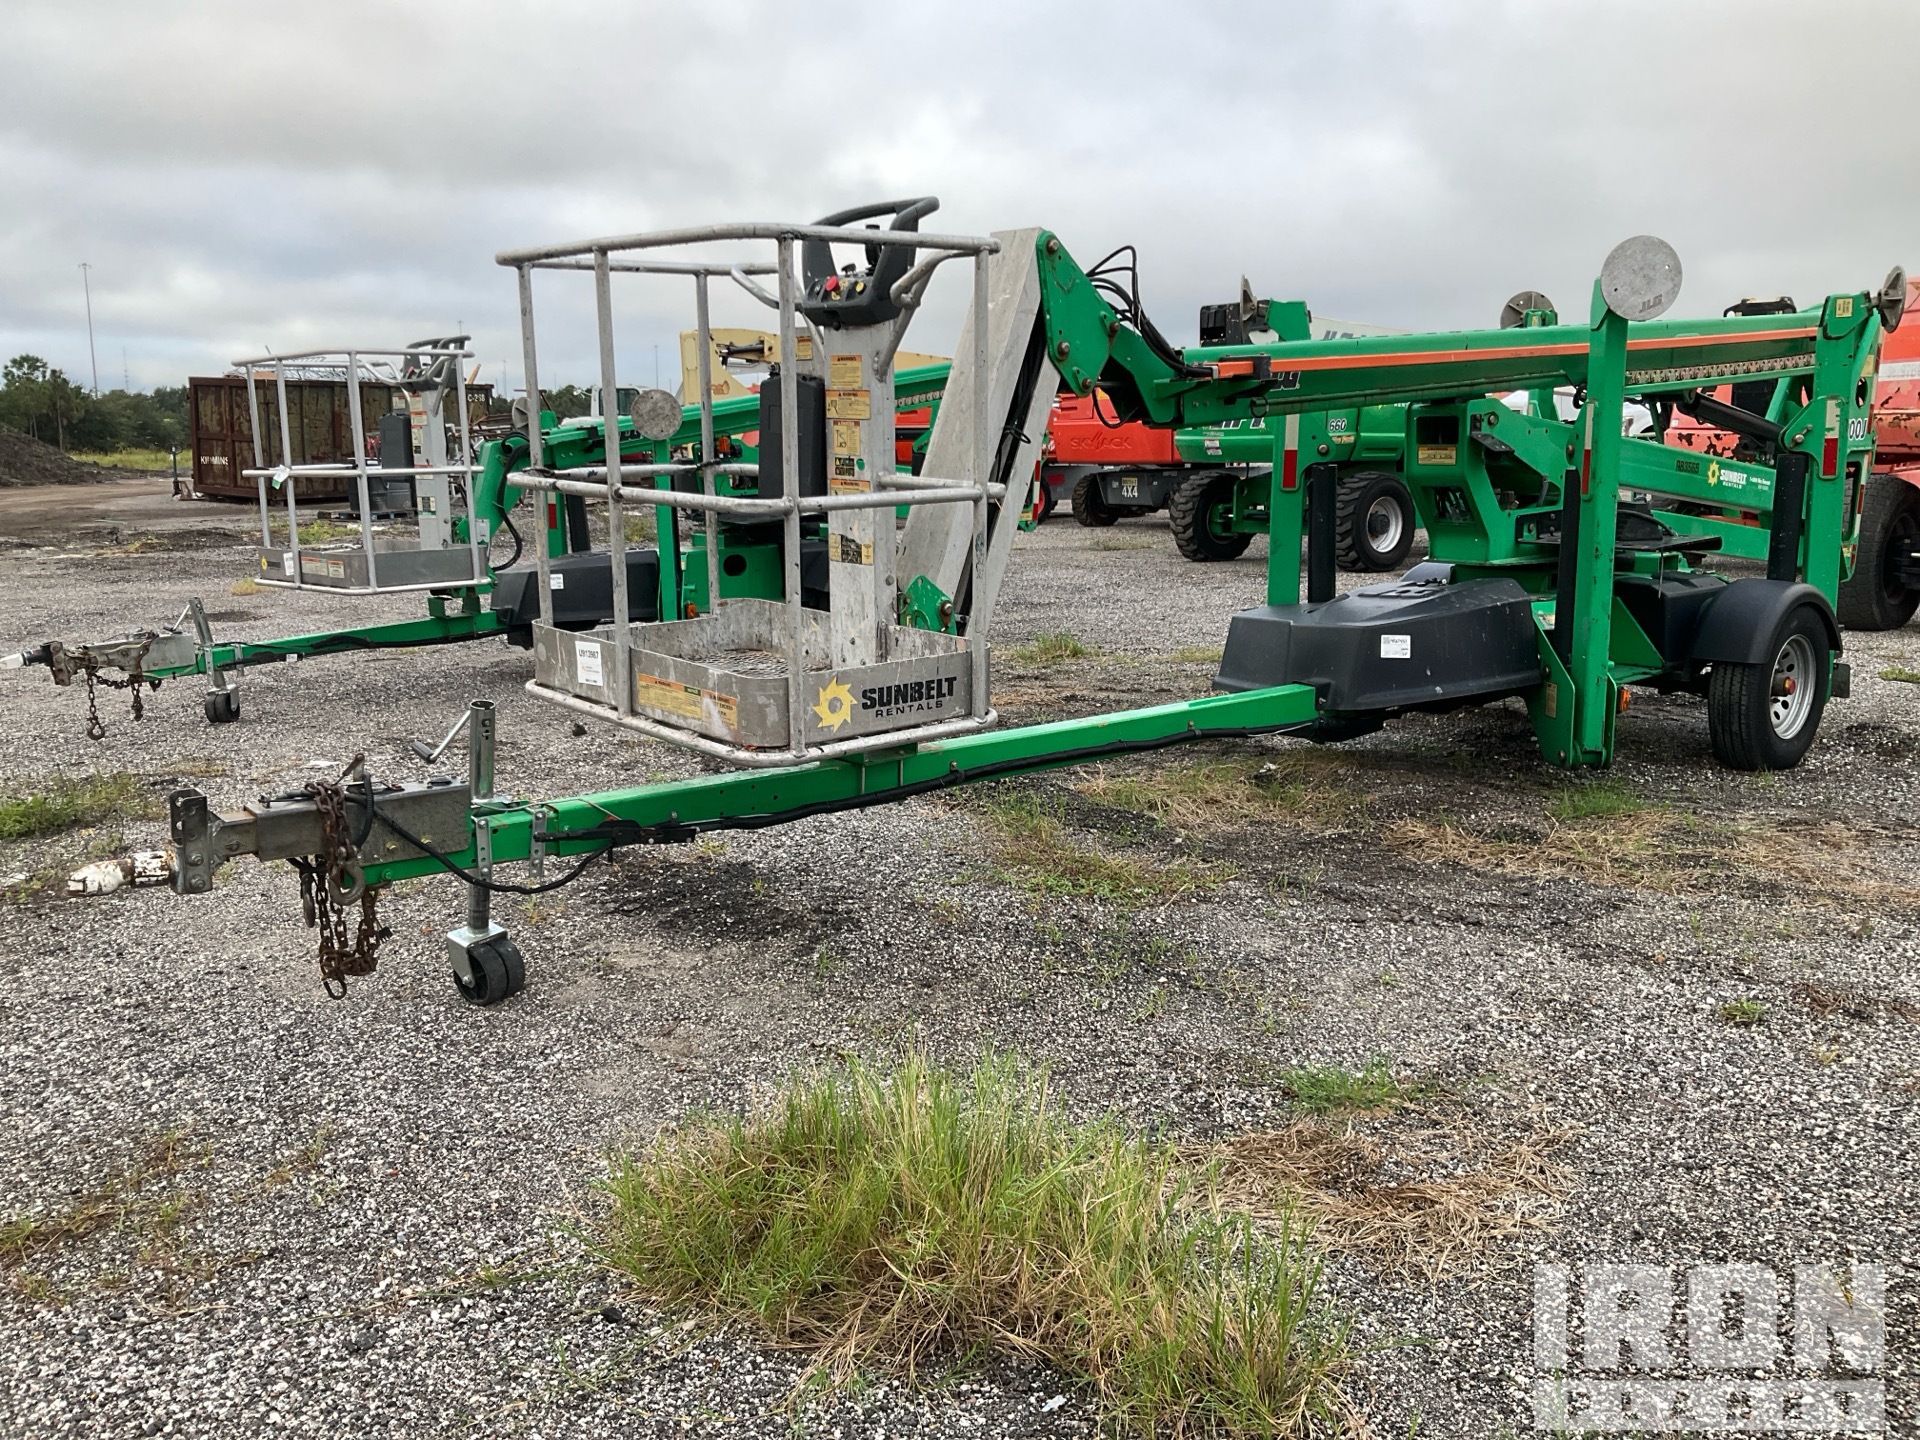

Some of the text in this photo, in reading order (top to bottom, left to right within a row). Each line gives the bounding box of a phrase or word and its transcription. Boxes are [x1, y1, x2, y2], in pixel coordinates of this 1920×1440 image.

[1328, 418, 1347, 432] 660
[1847, 417, 1868, 441] 00J
[1070, 431, 1132, 452] SKYJACK
[1719, 469, 1747, 485] SUNBELT
[1722, 481, 1743, 489] RENTALS
[1121, 485, 1138, 498] 4X4
[861, 676, 957, 710] SUNBELT
[875, 700, 943, 718] RENTALS
